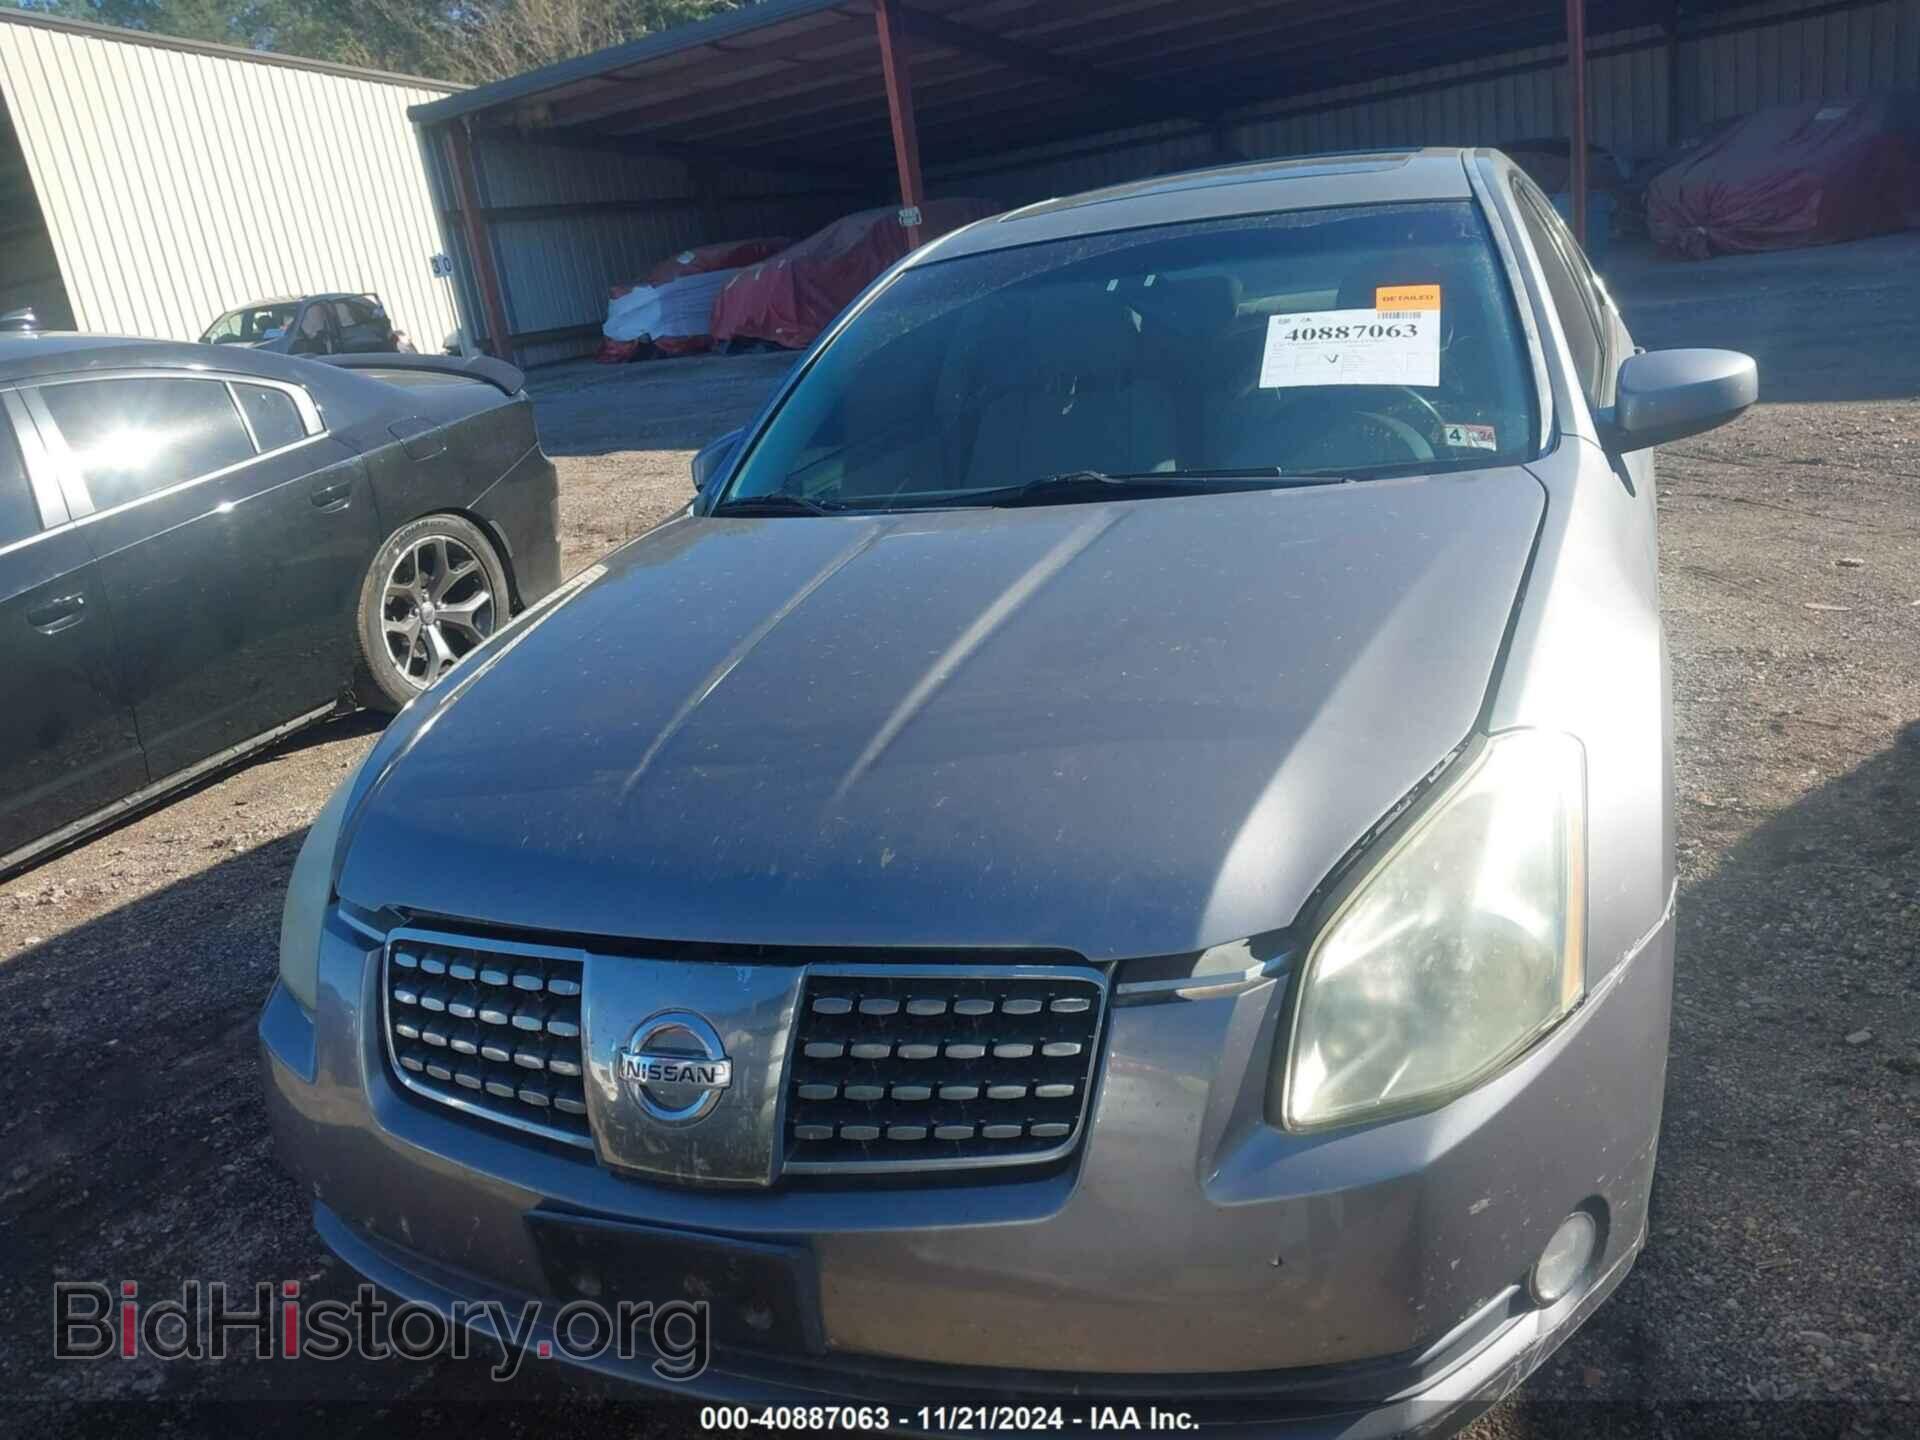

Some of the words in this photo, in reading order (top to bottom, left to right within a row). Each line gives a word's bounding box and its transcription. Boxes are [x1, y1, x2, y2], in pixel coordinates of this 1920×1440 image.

[431, 257, 452, 274] 30
[1381, 294, 1435, 302] DETAILED
[1284, 323, 1418, 342] 40887063
[1449, 427, 1462, 441] 4
[626, 1060, 716, 1084] NISSAN
